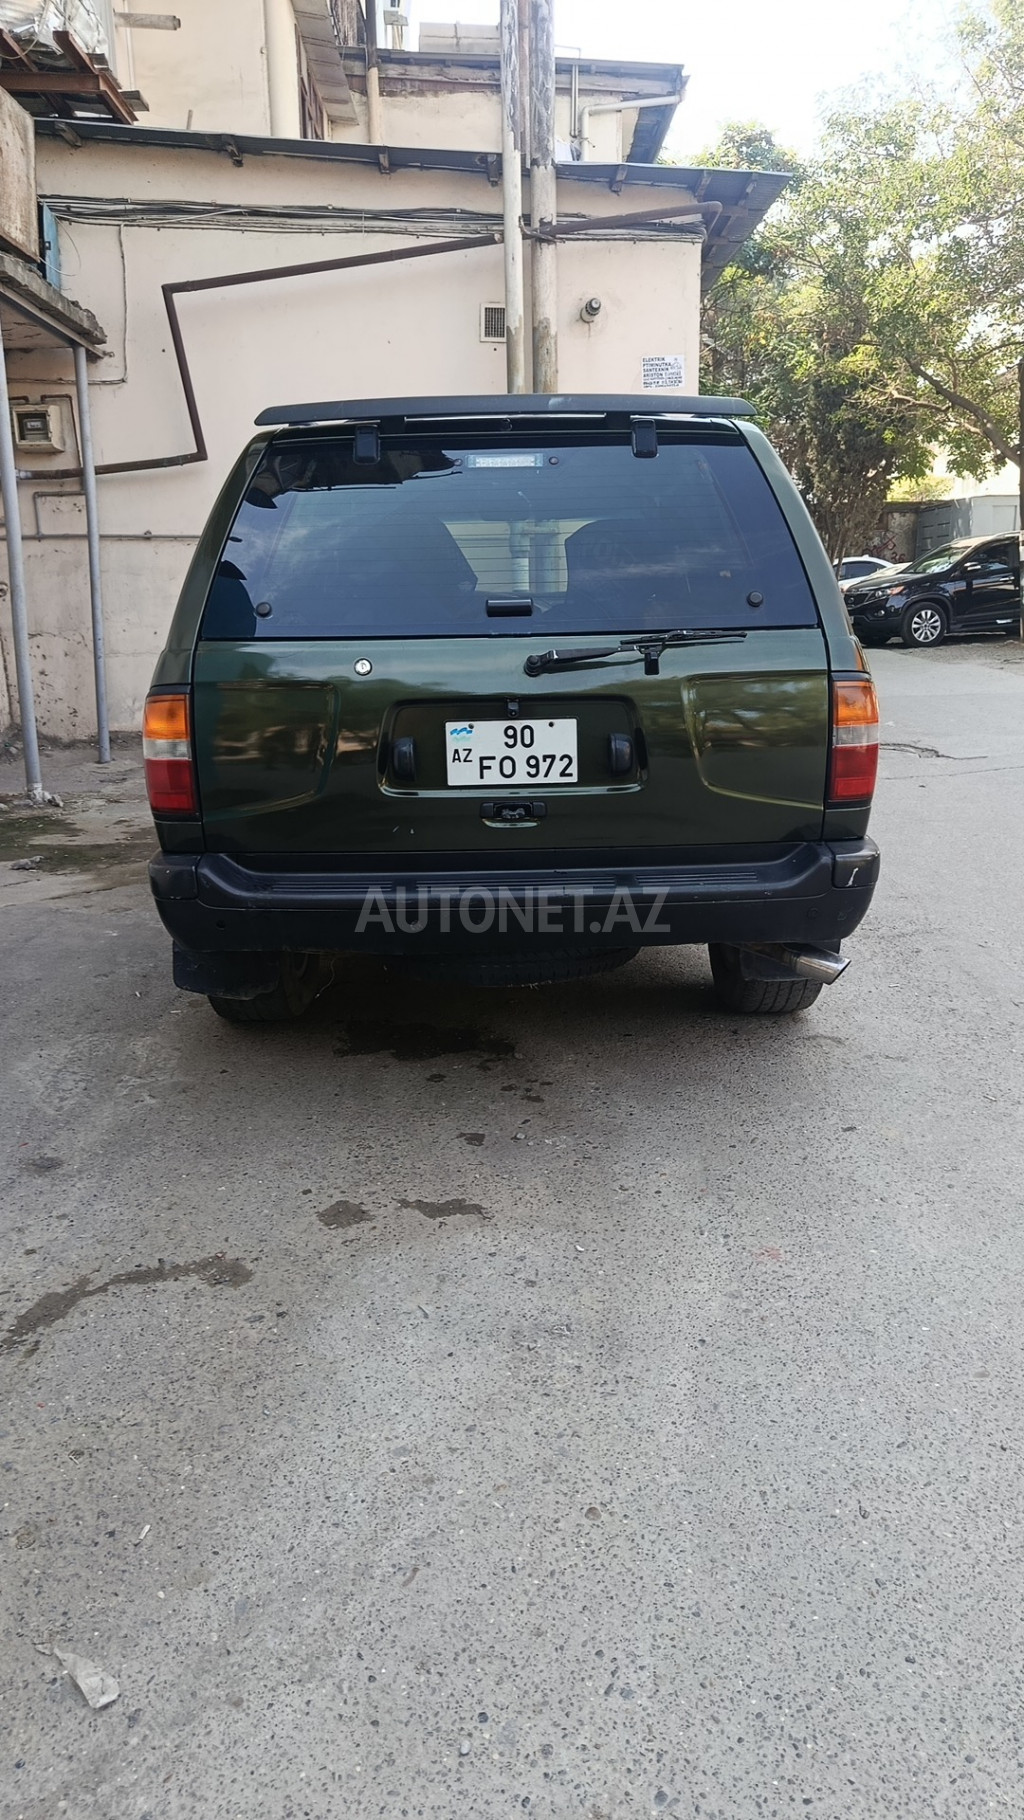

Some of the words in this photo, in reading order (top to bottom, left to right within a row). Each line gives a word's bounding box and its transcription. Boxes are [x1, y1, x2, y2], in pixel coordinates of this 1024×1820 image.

[504, 725, 535, 748] 90
[452, 748, 473, 763] AZ
[479, 755, 517, 779] FO
[526, 753, 574, 778] 972
